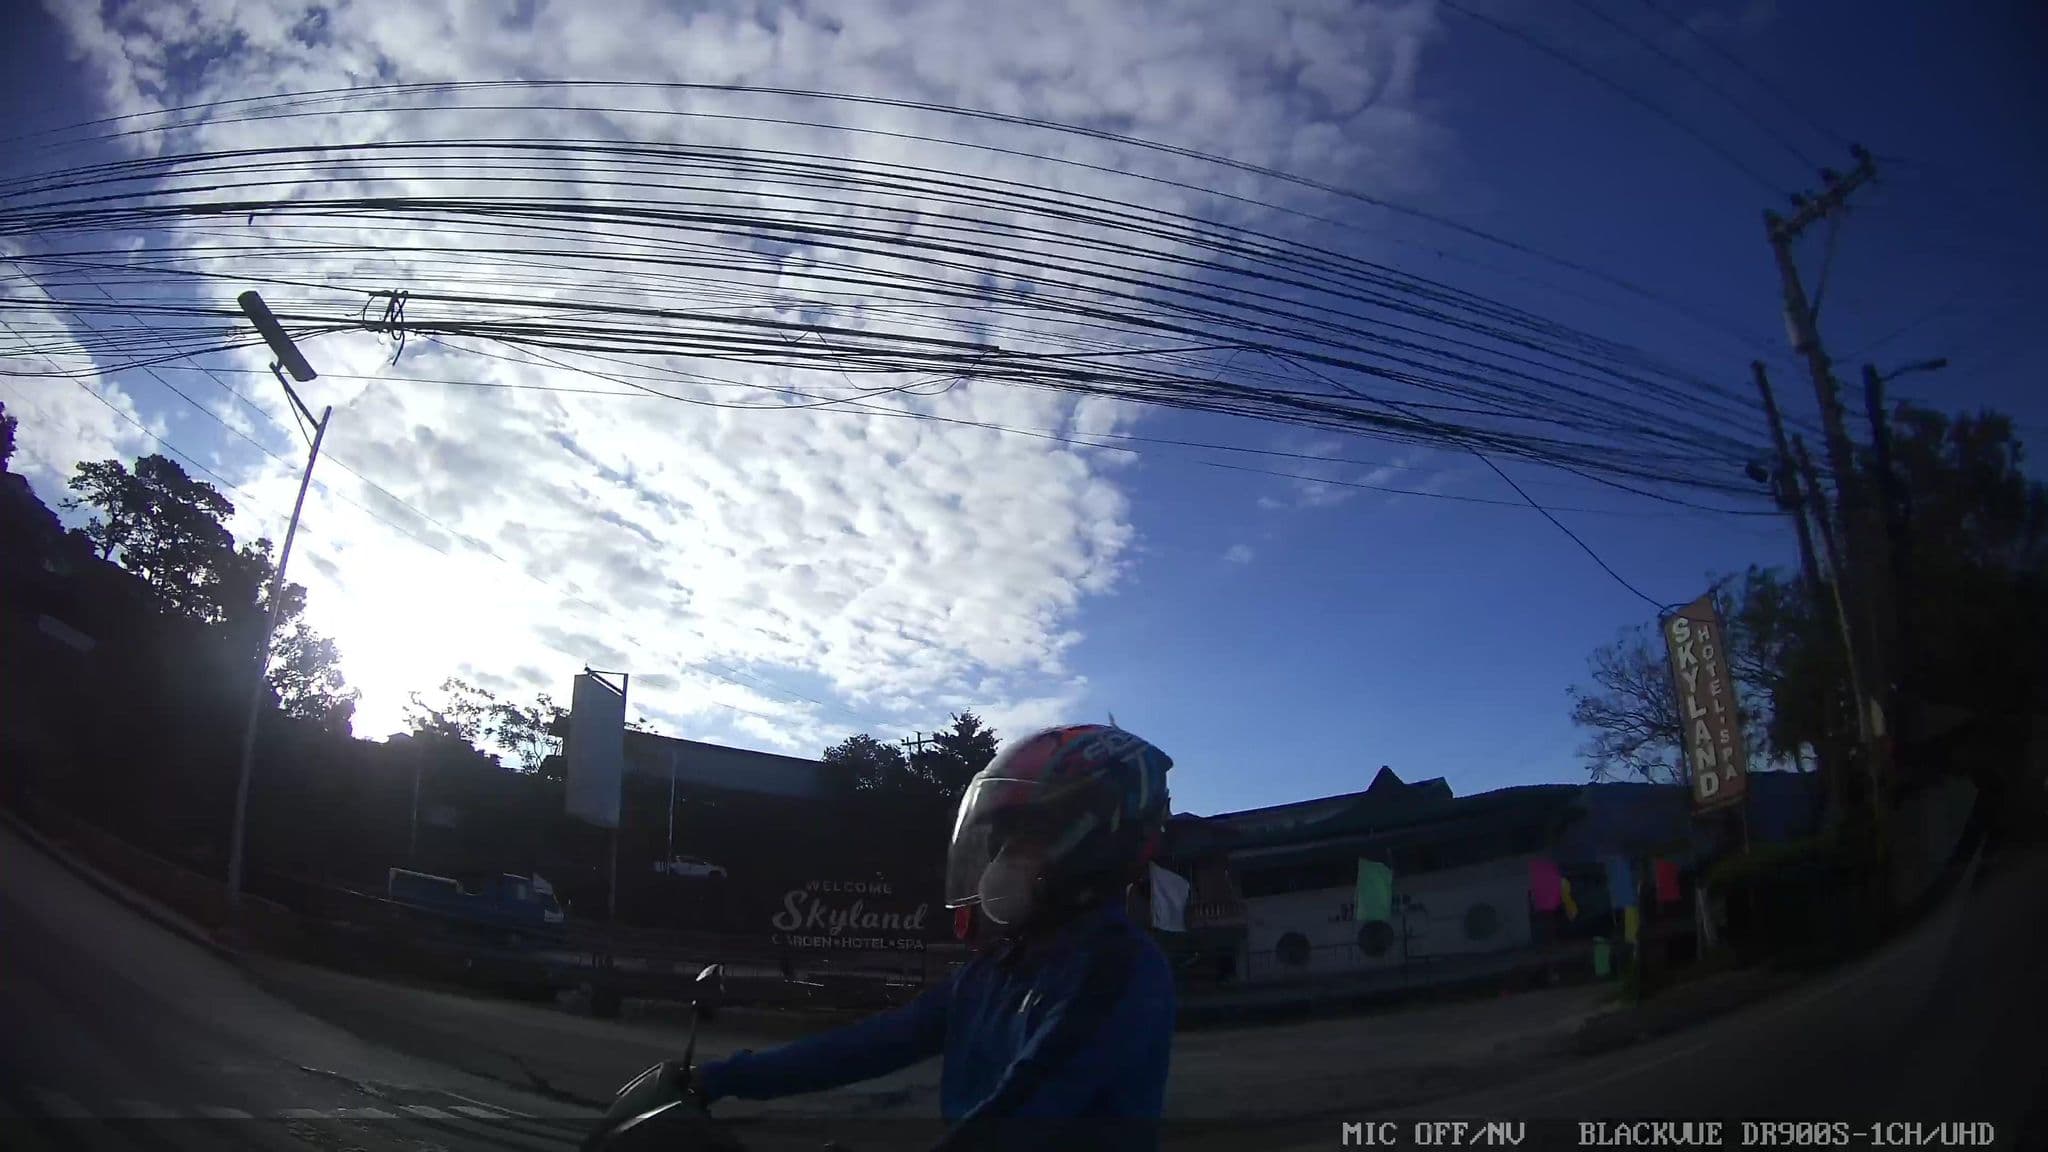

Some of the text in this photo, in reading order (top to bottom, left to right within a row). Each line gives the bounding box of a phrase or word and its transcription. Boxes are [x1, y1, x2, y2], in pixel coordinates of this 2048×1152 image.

[1672, 617, 1719, 797] SKYLAND
[806, 880, 893, 895] WELCOME
[771, 890, 928, 936] Skyland
